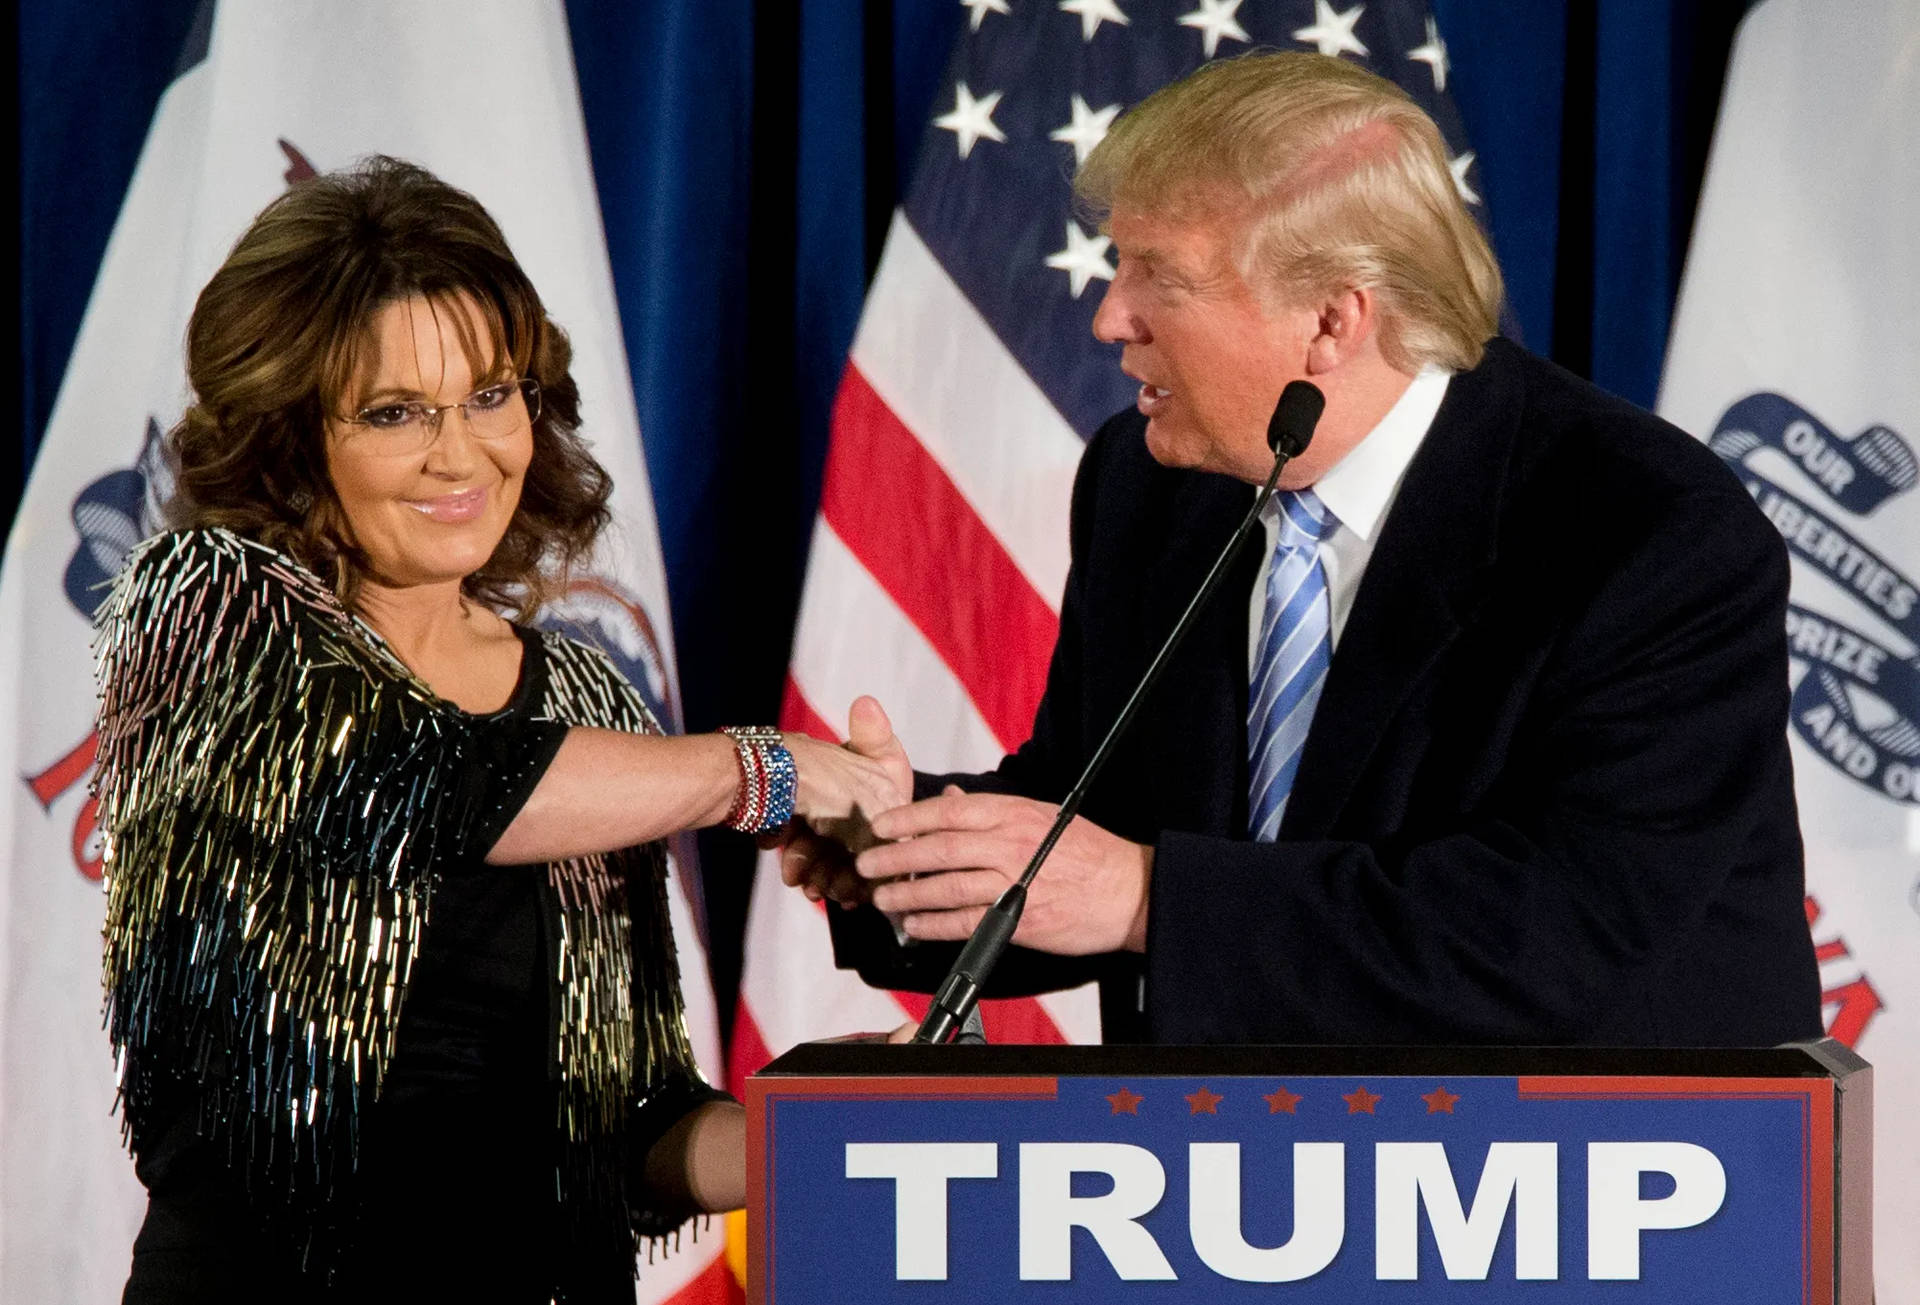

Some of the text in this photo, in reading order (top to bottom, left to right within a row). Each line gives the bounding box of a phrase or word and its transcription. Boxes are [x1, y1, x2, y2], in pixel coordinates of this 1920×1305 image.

[1783, 420, 1856, 495] OUR
[1803, 704, 1920, 801] AND O
[846, 1142, 1726, 1282] TRUMP
